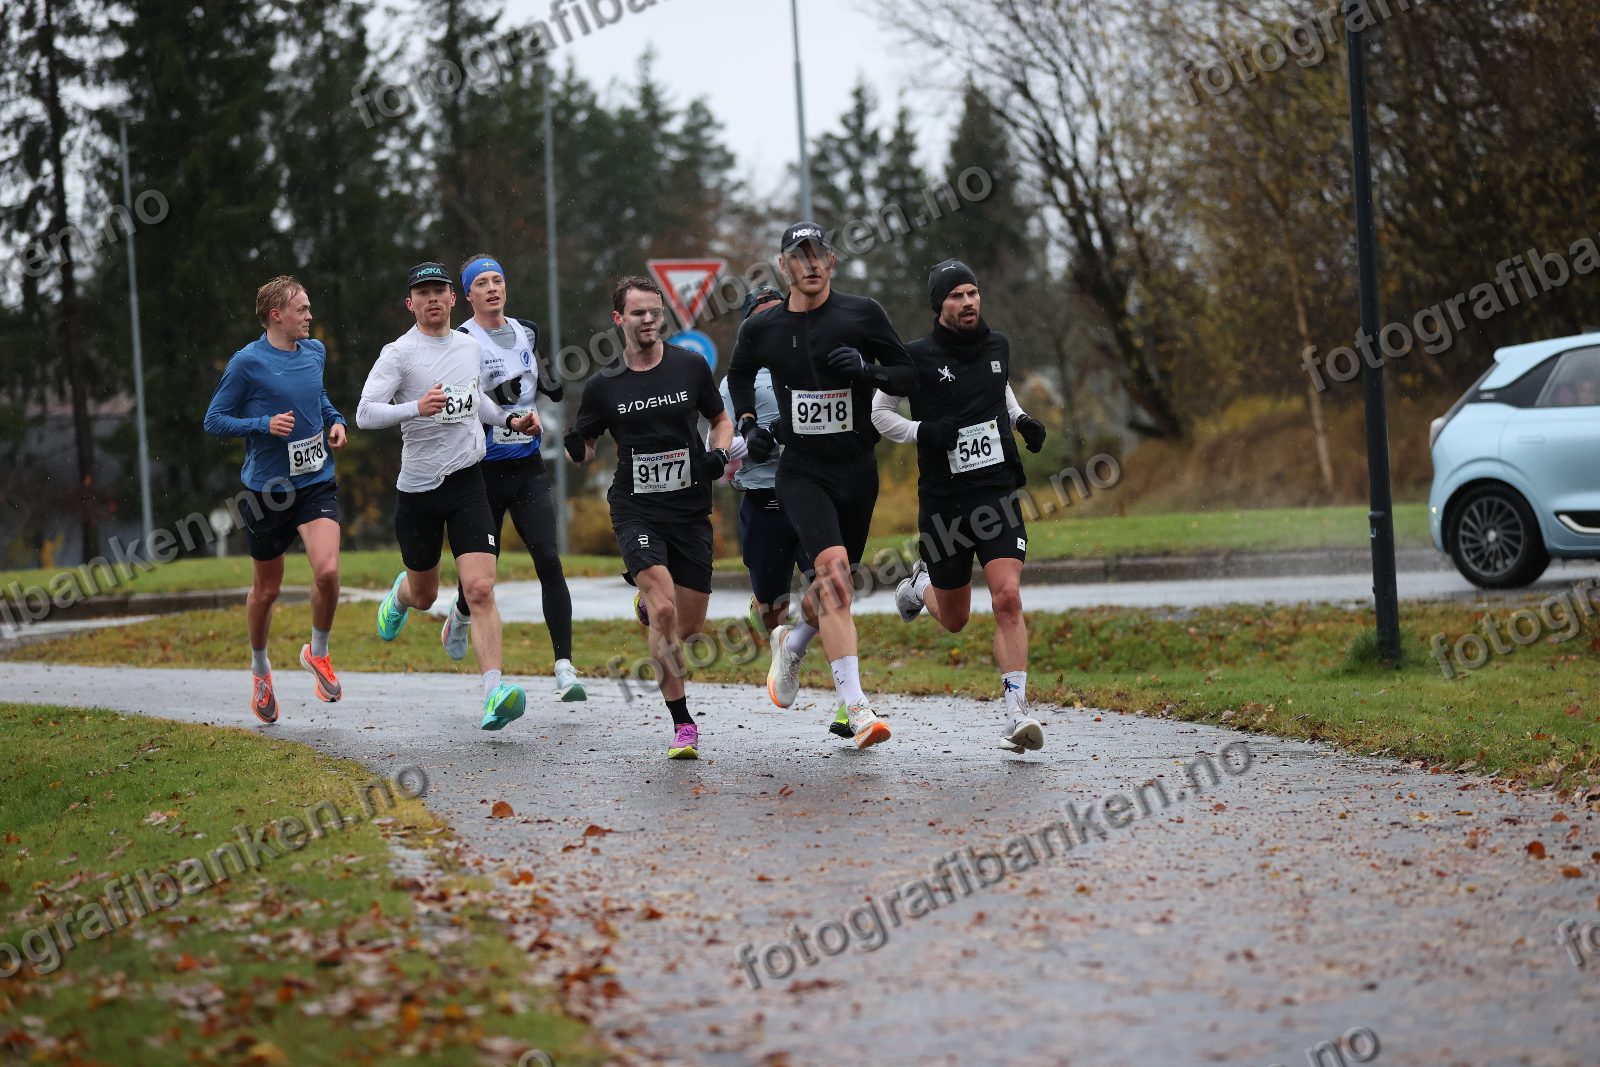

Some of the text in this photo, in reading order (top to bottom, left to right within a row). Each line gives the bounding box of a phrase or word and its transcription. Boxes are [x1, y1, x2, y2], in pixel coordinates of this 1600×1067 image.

[792, 229, 822, 240] HOKA
[417, 268, 442, 278] HOKA
[446, 394, 473, 415] 614
[797, 401, 848, 424] 9218
[293, 442, 323, 467] 9478
[638, 451, 686, 462] NORGESTESTEN
[958, 435, 992, 462] 546
[638, 460, 686, 483] 9177
